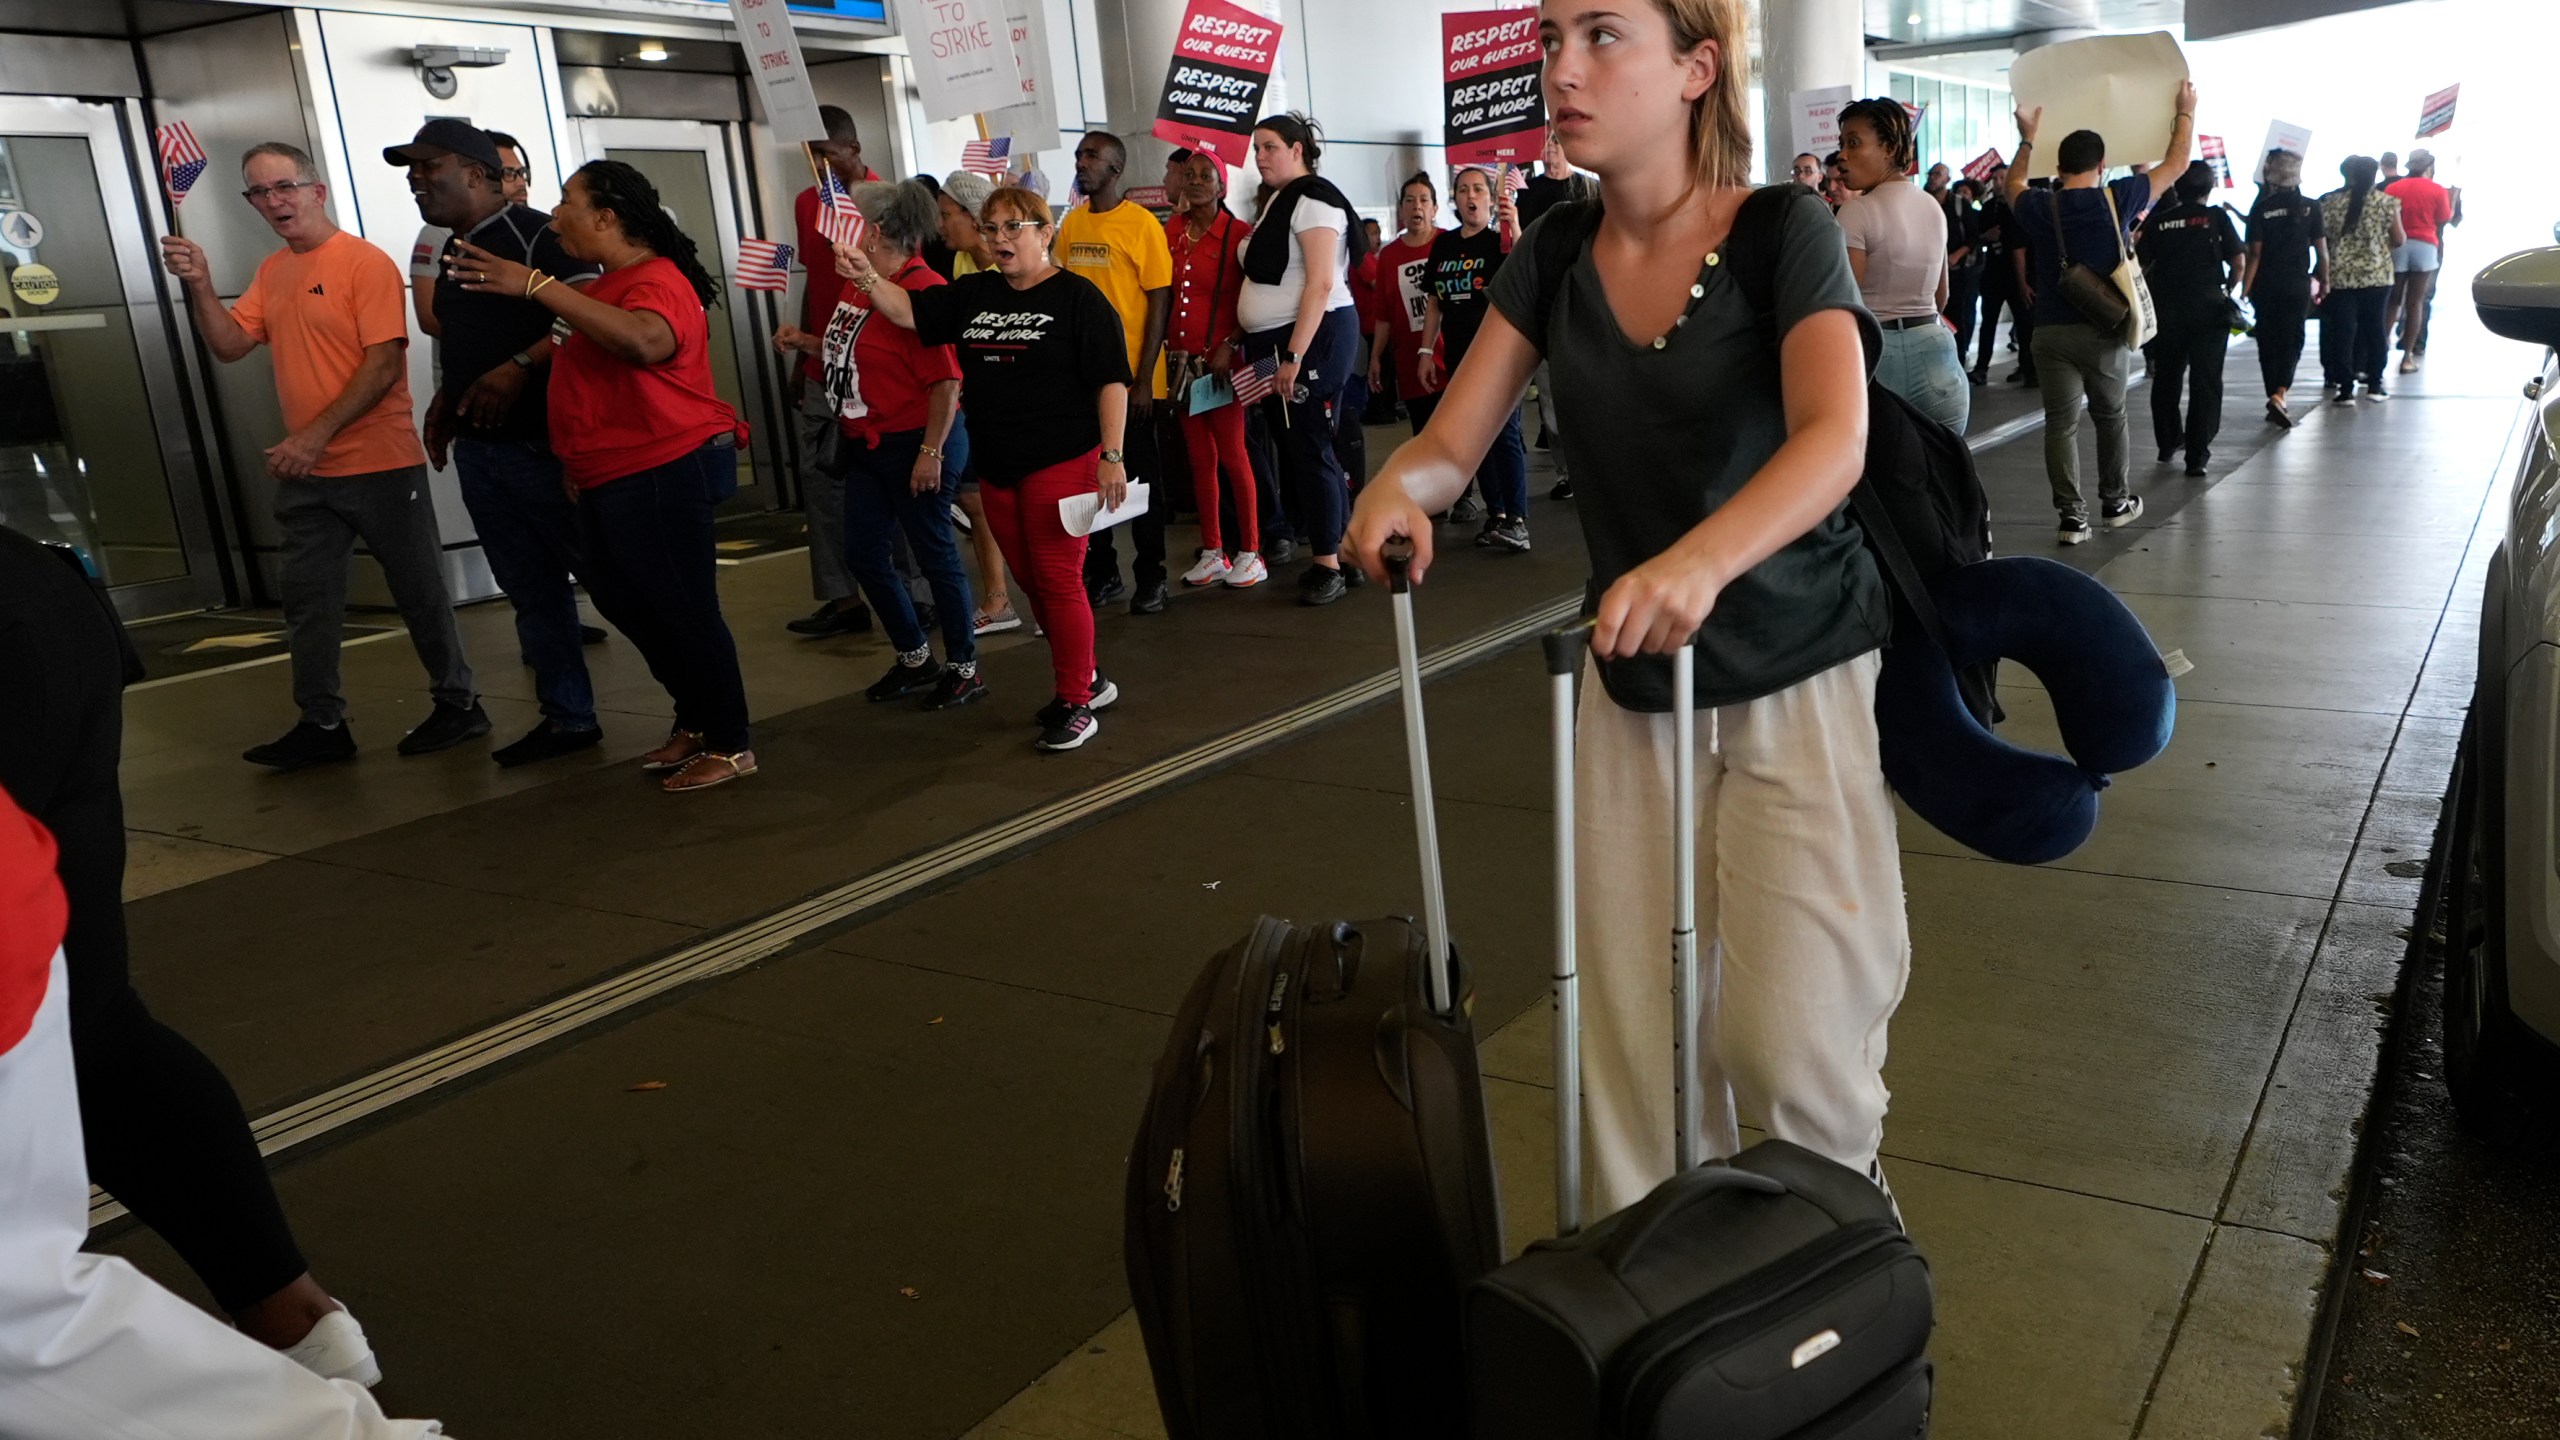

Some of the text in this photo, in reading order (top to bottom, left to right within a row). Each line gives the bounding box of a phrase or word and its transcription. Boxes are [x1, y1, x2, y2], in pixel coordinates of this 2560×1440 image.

[933, 2, 965, 24] TO
[757, 22, 770, 38] TO
[930, 21, 992, 58] STRIKE
[1188, 14, 1273, 45] RESPECT
[1450, 17, 1536, 54] RESPECT
[760, 50, 789, 70] STRIKE
[1182, 37, 1268, 63] OUR GUESTS
[1449, 39, 1537, 73] OUR GUESTS
[1174, 66, 1258, 98] RESPECT
[1451, 74, 1537, 107] RESPECT
[1168, 90, 1253, 114] OUR WORK
[1451, 94, 1538, 127] OUR WORK
[1808, 107, 1836, 117] READY
[1818, 122, 1829, 130] TO
[1437, 254, 1485, 273] union
[14, 280, 58, 290] CAUTION
[1435, 271, 1484, 301] pride
[970, 311, 1054, 328] RESPECT
[962, 328, 1046, 341] OUR WORK
